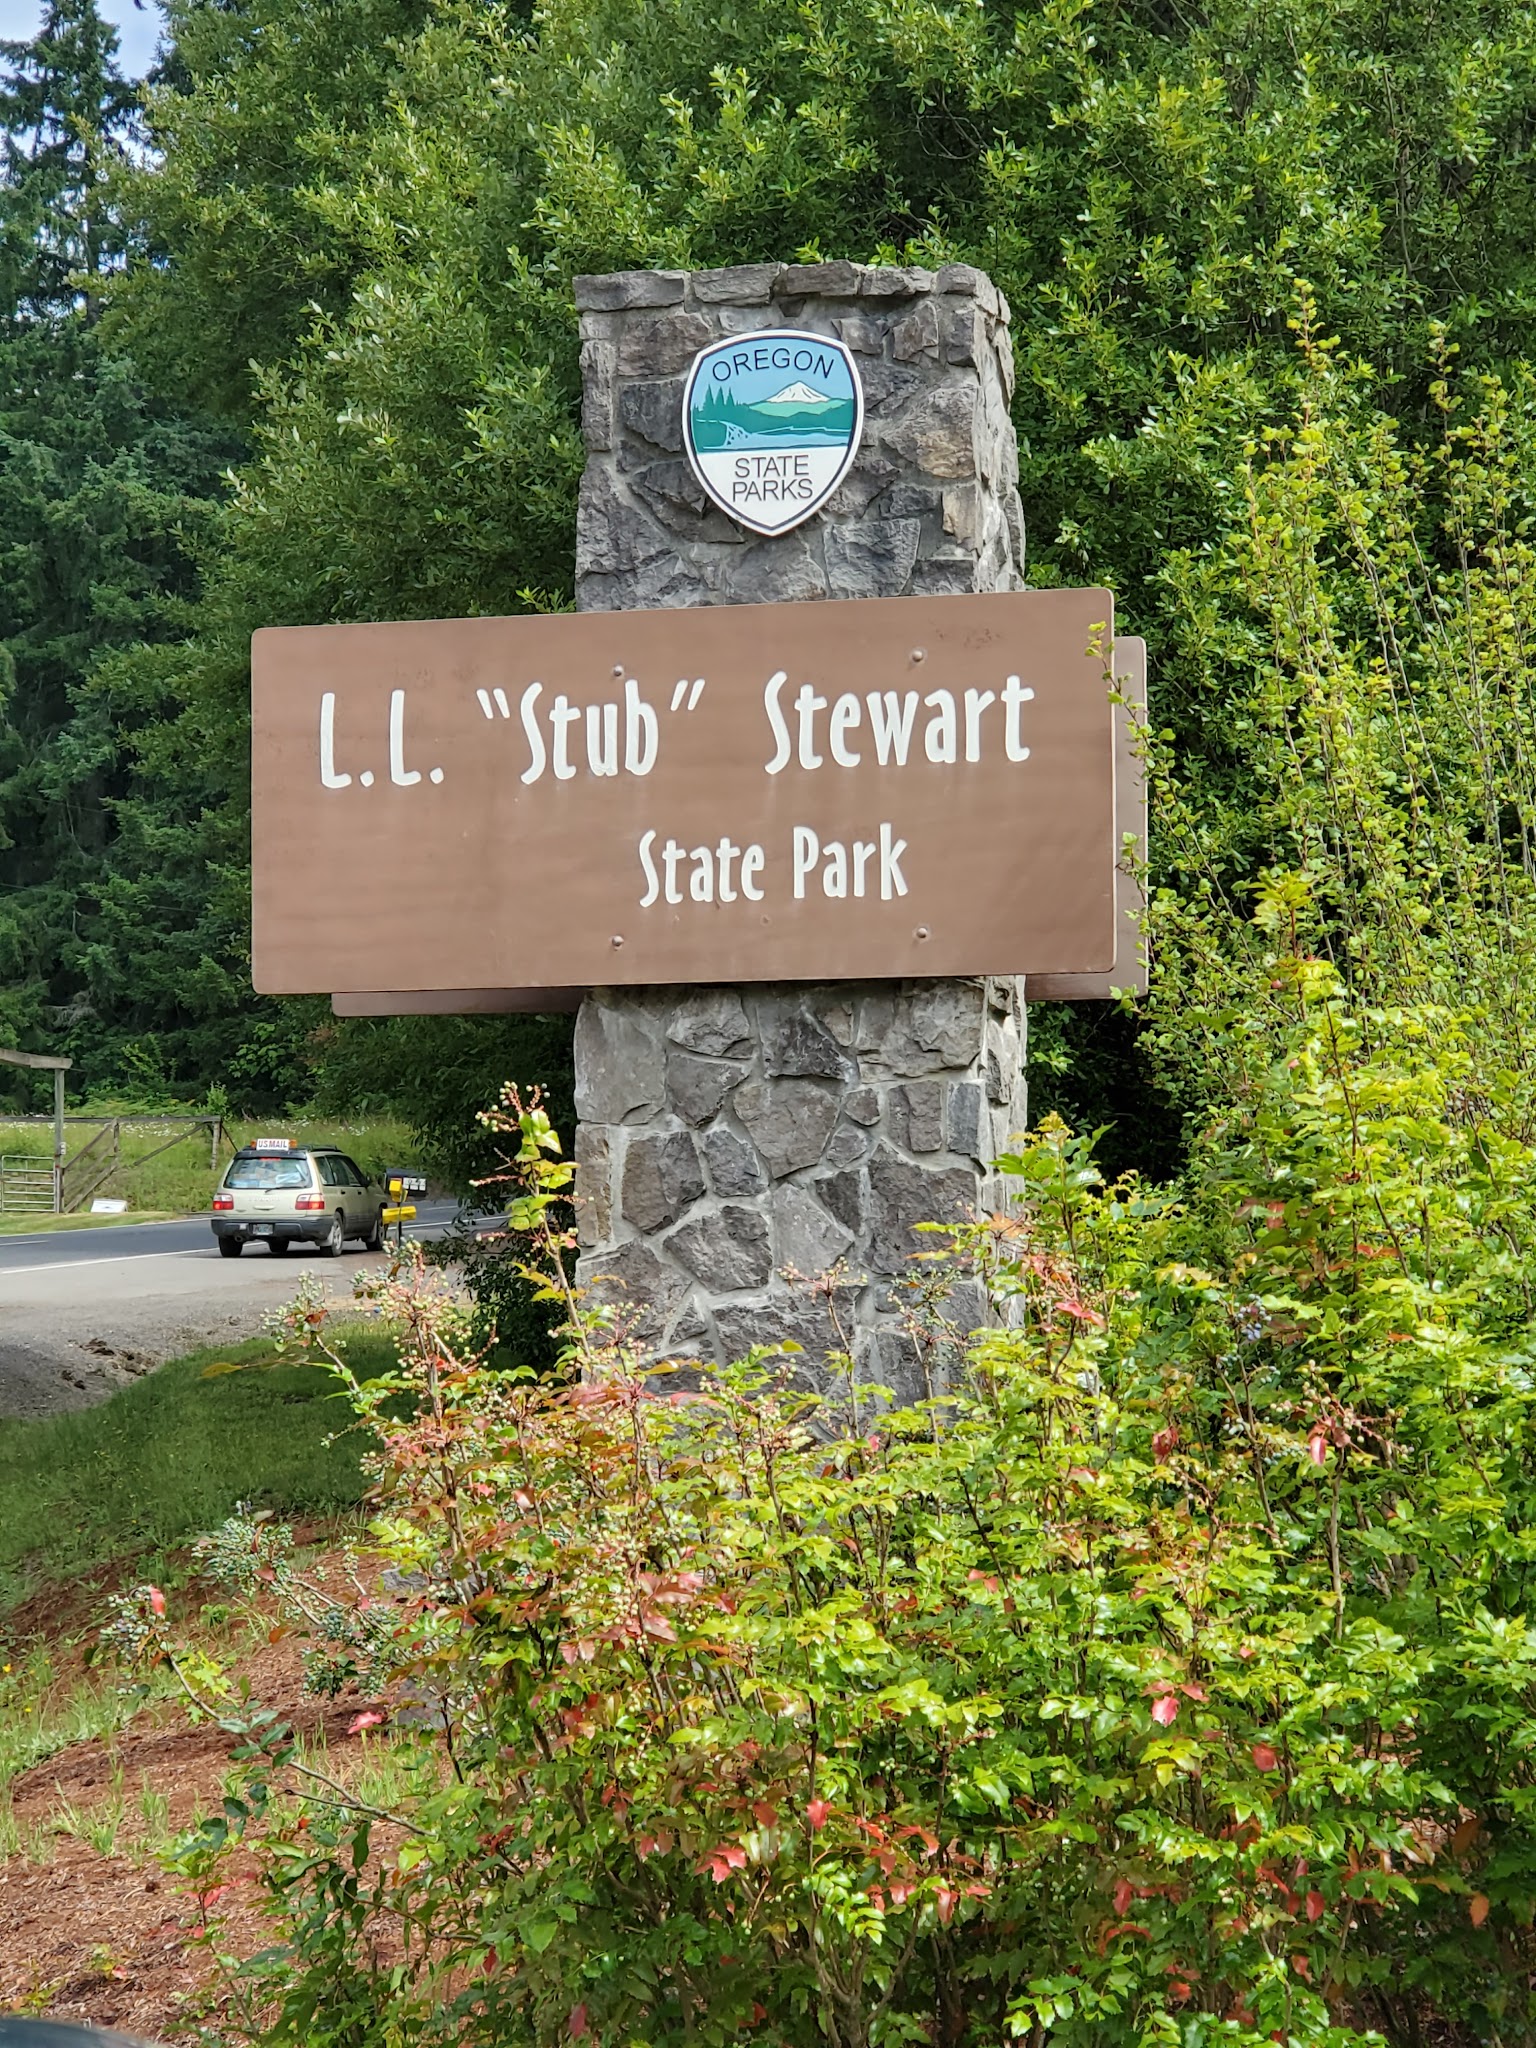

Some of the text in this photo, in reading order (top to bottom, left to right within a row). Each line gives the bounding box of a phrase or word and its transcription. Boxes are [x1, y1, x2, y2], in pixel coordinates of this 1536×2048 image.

[712, 347, 834, 382] OREGON
[734, 454, 810, 479] STATE
[732, 478, 814, 503] PARKS
[319, 688, 446, 791] L.L.
[763, 669, 1037, 777] Stewart
[637, 821, 910, 909] State Park
[269, 1140, 287, 1148] MAIL
